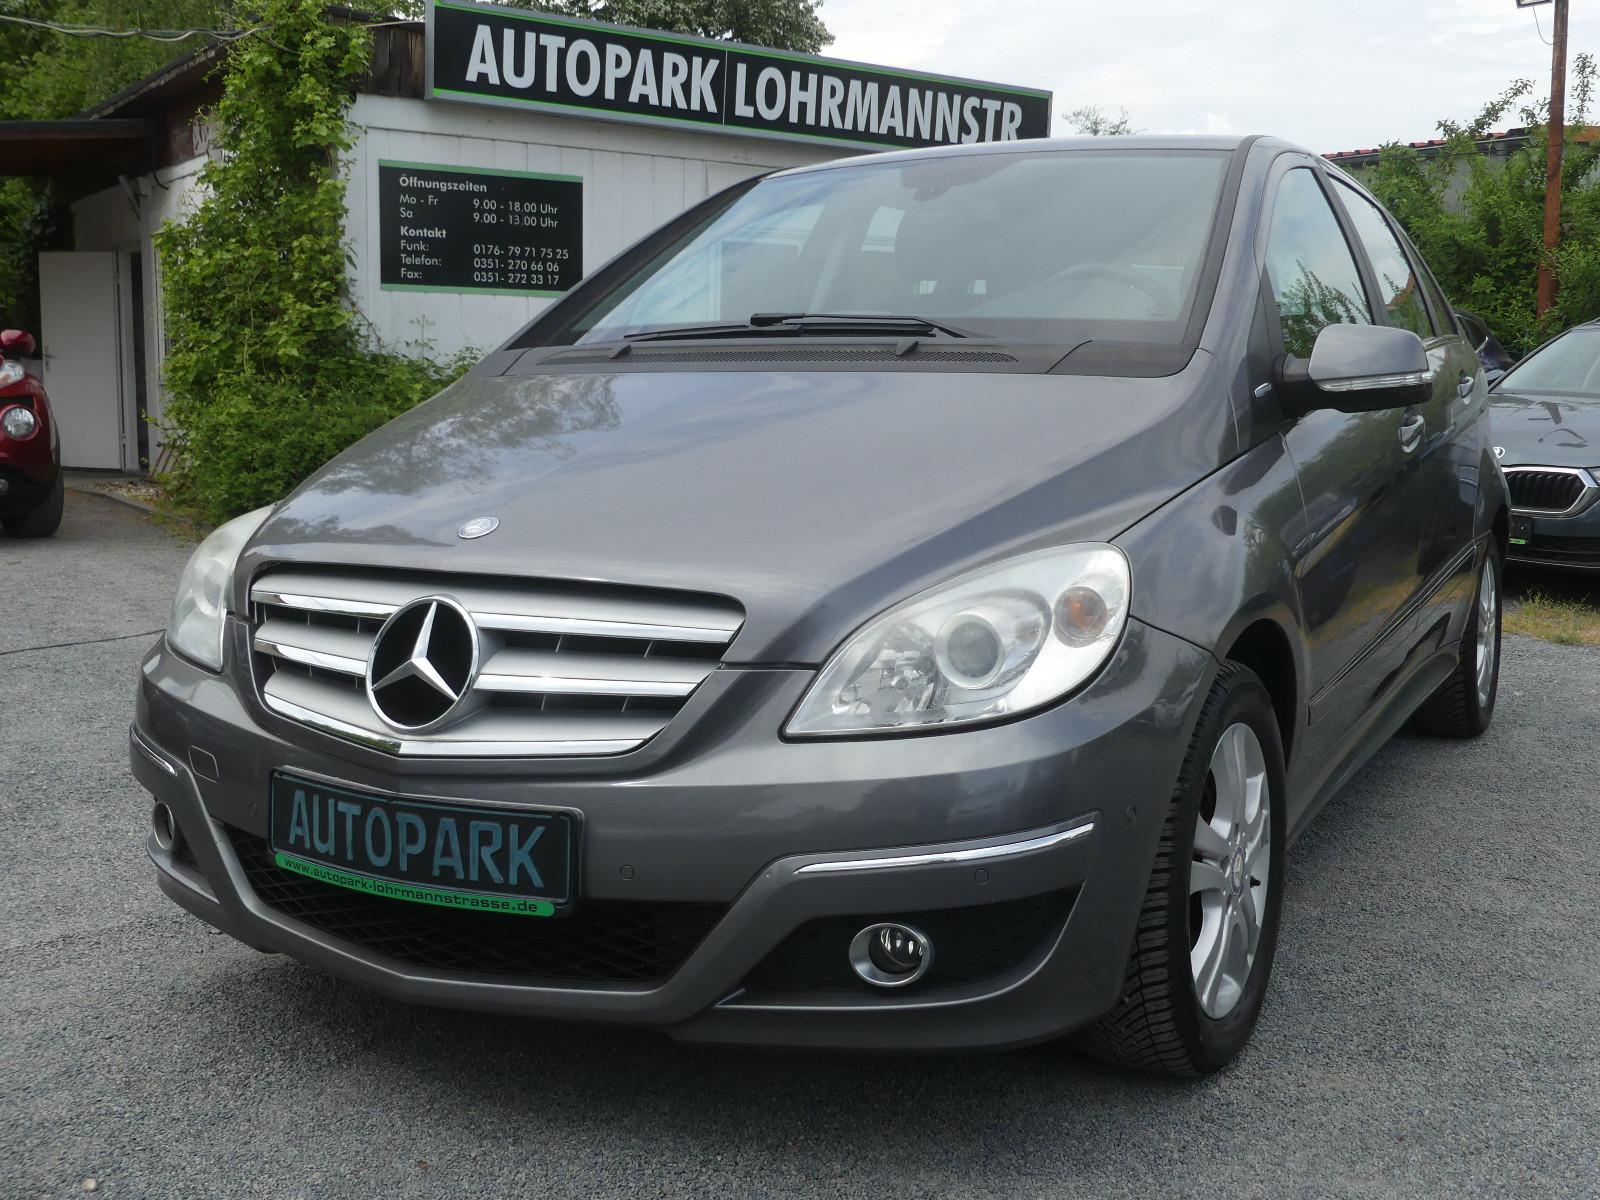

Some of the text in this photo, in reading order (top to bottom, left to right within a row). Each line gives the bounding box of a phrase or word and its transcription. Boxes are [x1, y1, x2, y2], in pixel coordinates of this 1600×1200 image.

[465, 23, 1023, 145] AUTOPARK LOHRMANNSTR
[399, 174, 487, 193] Öffnungszeiten
[399, 194, 417, 204] Mo
[428, 195, 439, 206] Fr
[473, 198, 497, 210] 9.00
[508, 200, 537, 213] 18.00
[540, 203, 559, 214] Uhr
[400, 207, 413, 218] Sa
[473, 212, 497, 224] 9.00
[508, 214, 537, 227] 13.00
[540, 216, 559, 228] Uhr
[400, 226, 447, 238] Kontakt
[400, 240, 429, 251] Funk:
[508, 246, 520, 257] 79
[524, 247, 536, 258] 71
[540, 248, 553, 259] 75
[556, 249, 569, 260] 25
[400, 254, 442, 266] Telefon:
[508, 260, 528, 271] 270
[530, 261, 544, 272] 66
[546, 261, 560, 273] 06
[400, 268, 423, 279] Fax:
[508, 273, 528, 284] 272
[530, 274, 544, 285] 33
[547, 275, 559, 286] 17
[288, 789, 546, 888] AUTOPARK
[284, 858, 538, 914] www.autopark-lohrmannstrasse.de
